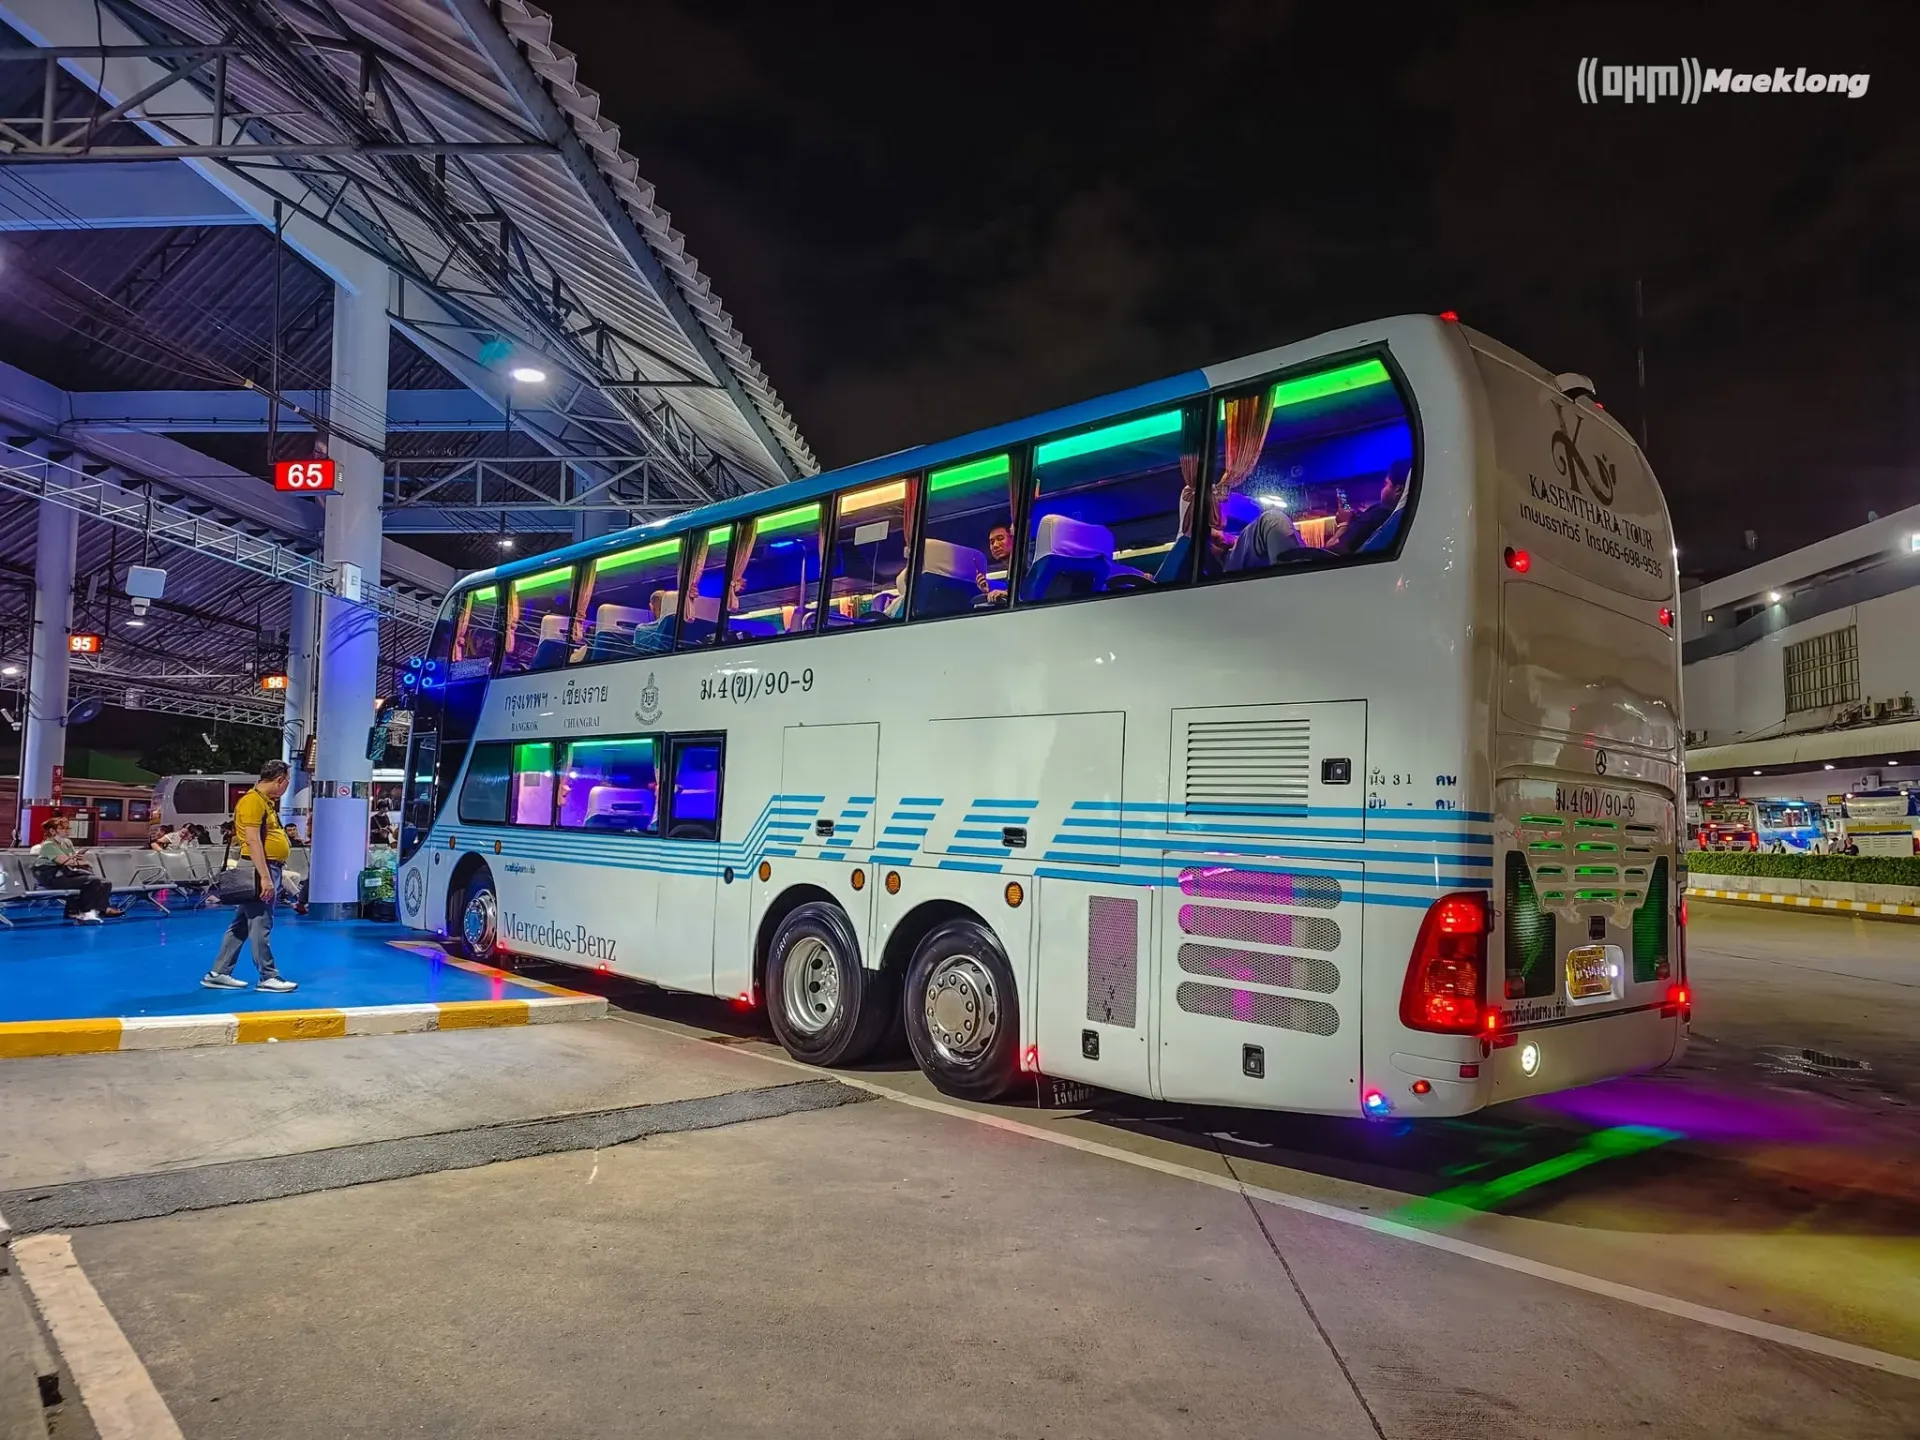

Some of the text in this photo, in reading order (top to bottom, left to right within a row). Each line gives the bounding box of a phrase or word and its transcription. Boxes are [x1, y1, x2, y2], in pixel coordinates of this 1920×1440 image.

[288, 463, 323, 488] 65
[1529, 474, 1654, 551] KASEMTHARA TOUR
[72, 636, 91, 651] 95
[267, 676, 283, 689] 96
[700, 668, 814, 704] ม.4(ข)/90-9
[504, 691, 549, 718] กรุงเทพฯ
[562, 680, 609, 705] เชียงราย
[511, 721, 539, 732] BANGKOK
[563, 716, 600, 729] CHIANGRAI
[1435, 775, 1457, 787] คน
[1555, 786, 1636, 819] ม.4(ข)/90-9
[503, 911, 617, 962] Mercedes-Benz
